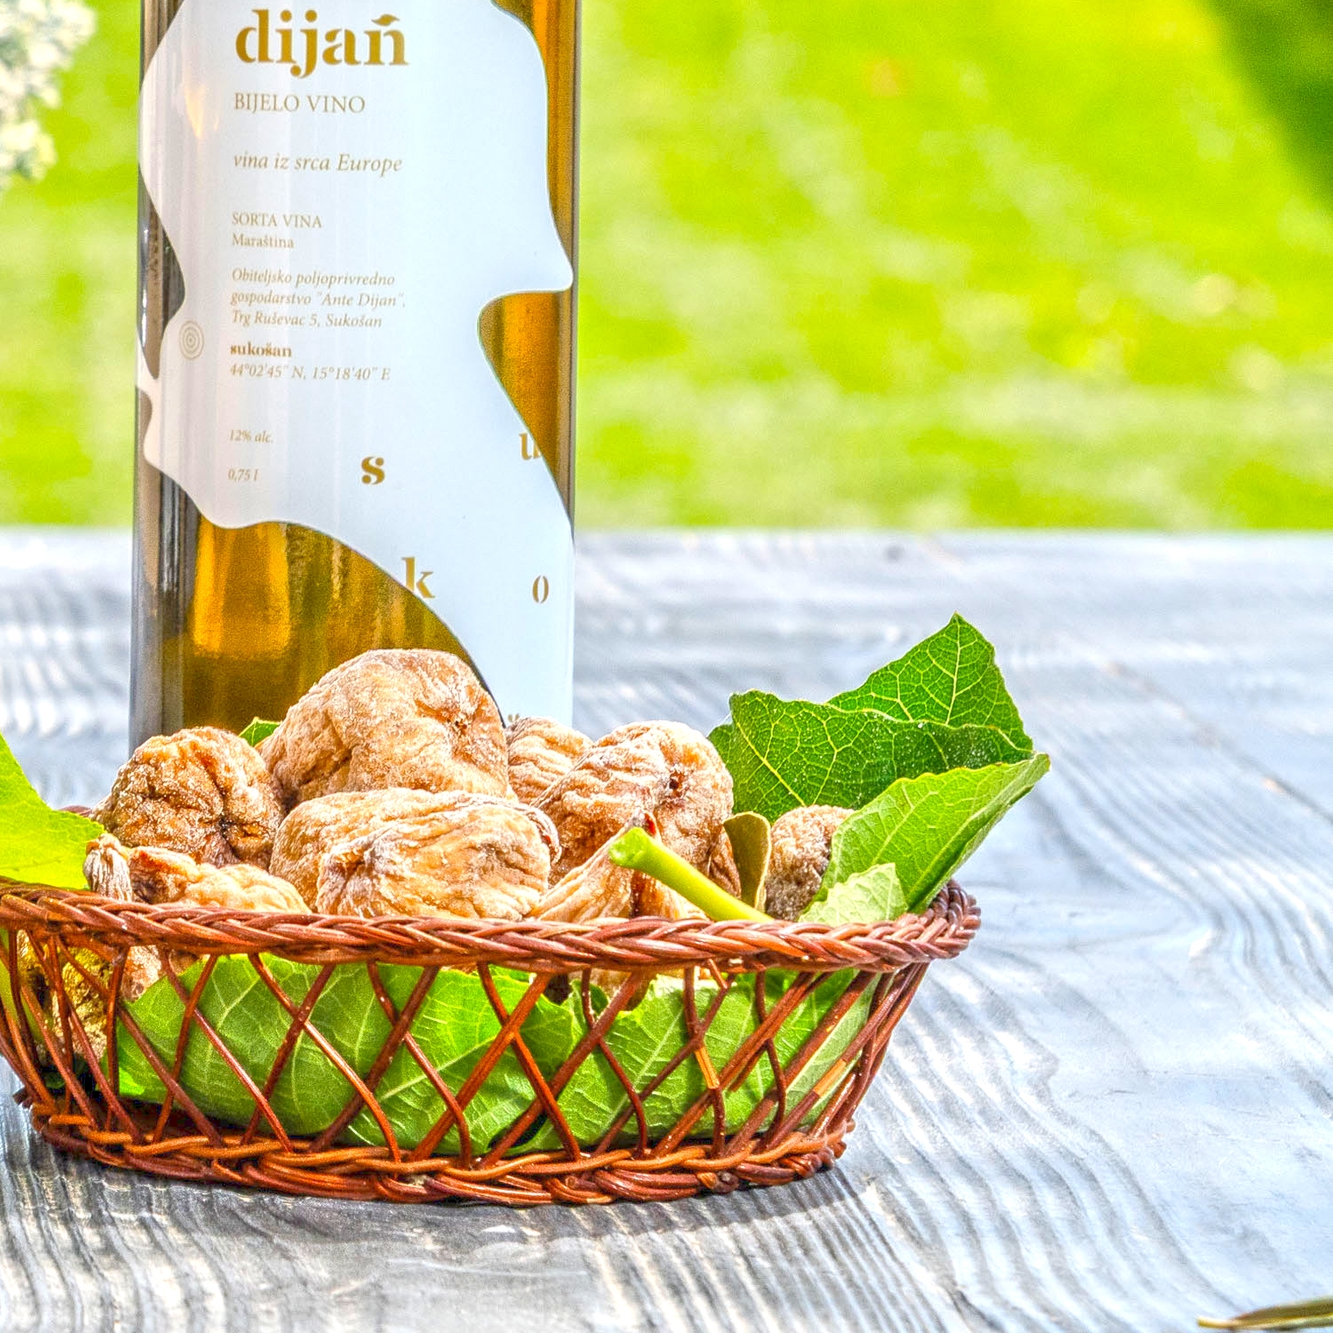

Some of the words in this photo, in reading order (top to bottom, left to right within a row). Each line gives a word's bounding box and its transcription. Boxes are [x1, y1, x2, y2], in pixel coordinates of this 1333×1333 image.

[234, 92, 299, 113] BIJELO
[306, 94, 366, 114] VINO
[233, 153, 269, 170] vina
[274, 154, 290, 170] iz
[294, 157, 330, 171] srca
[336, 154, 403, 178] Europe
[231, 212, 278, 228] SORTA
[282, 213, 323, 228] VINA
[231, 233, 295, 249] Maraština
[231, 268, 293, 286] Obiteljsko
[296, 270, 396, 289] poljoprivredno
[230, 289, 312, 307] gospodarstvo
[316, 292, 355, 307] "Ante
[231, 311, 251, 328] Trg
[254, 310, 307, 326] Ruševac
[310, 312, 321, 328] 5,
[325, 311, 383, 328] Sukošan
[230, 343, 292, 358] sukošan
[292, 365, 307, 381] N,
[381, 366, 391, 381] E
[229, 429, 252, 443] 12%
[255, 429, 274, 444] alc.
[228, 468, 252, 483] 0,75
[361, 456, 385, 485] s
[401, 556, 436, 599] k
